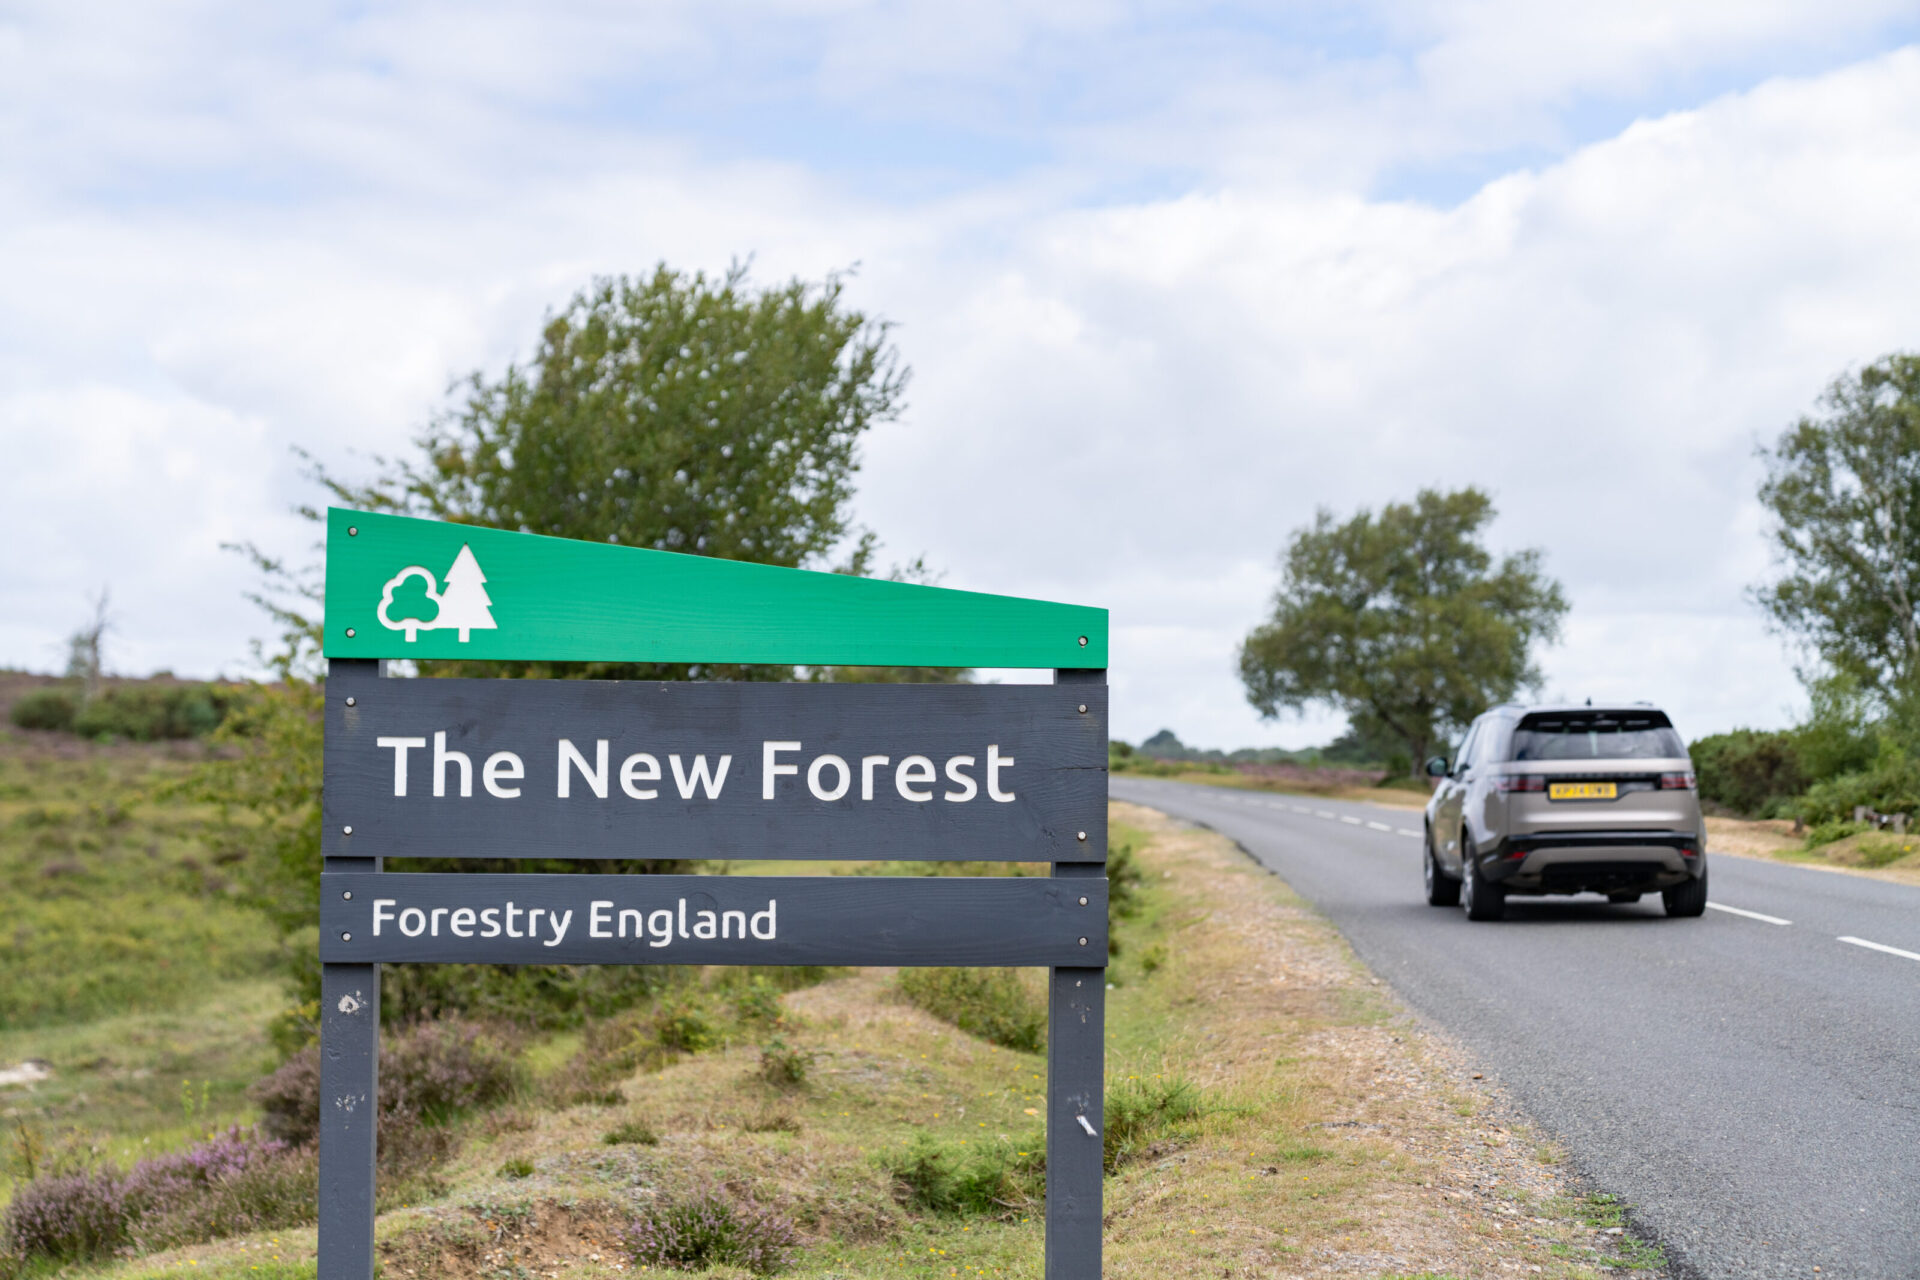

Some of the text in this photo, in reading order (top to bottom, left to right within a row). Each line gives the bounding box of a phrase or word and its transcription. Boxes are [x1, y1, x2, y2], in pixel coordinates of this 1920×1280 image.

[376, 730, 1016, 803] The New Forest
[372, 898, 777, 948] Forestry England
